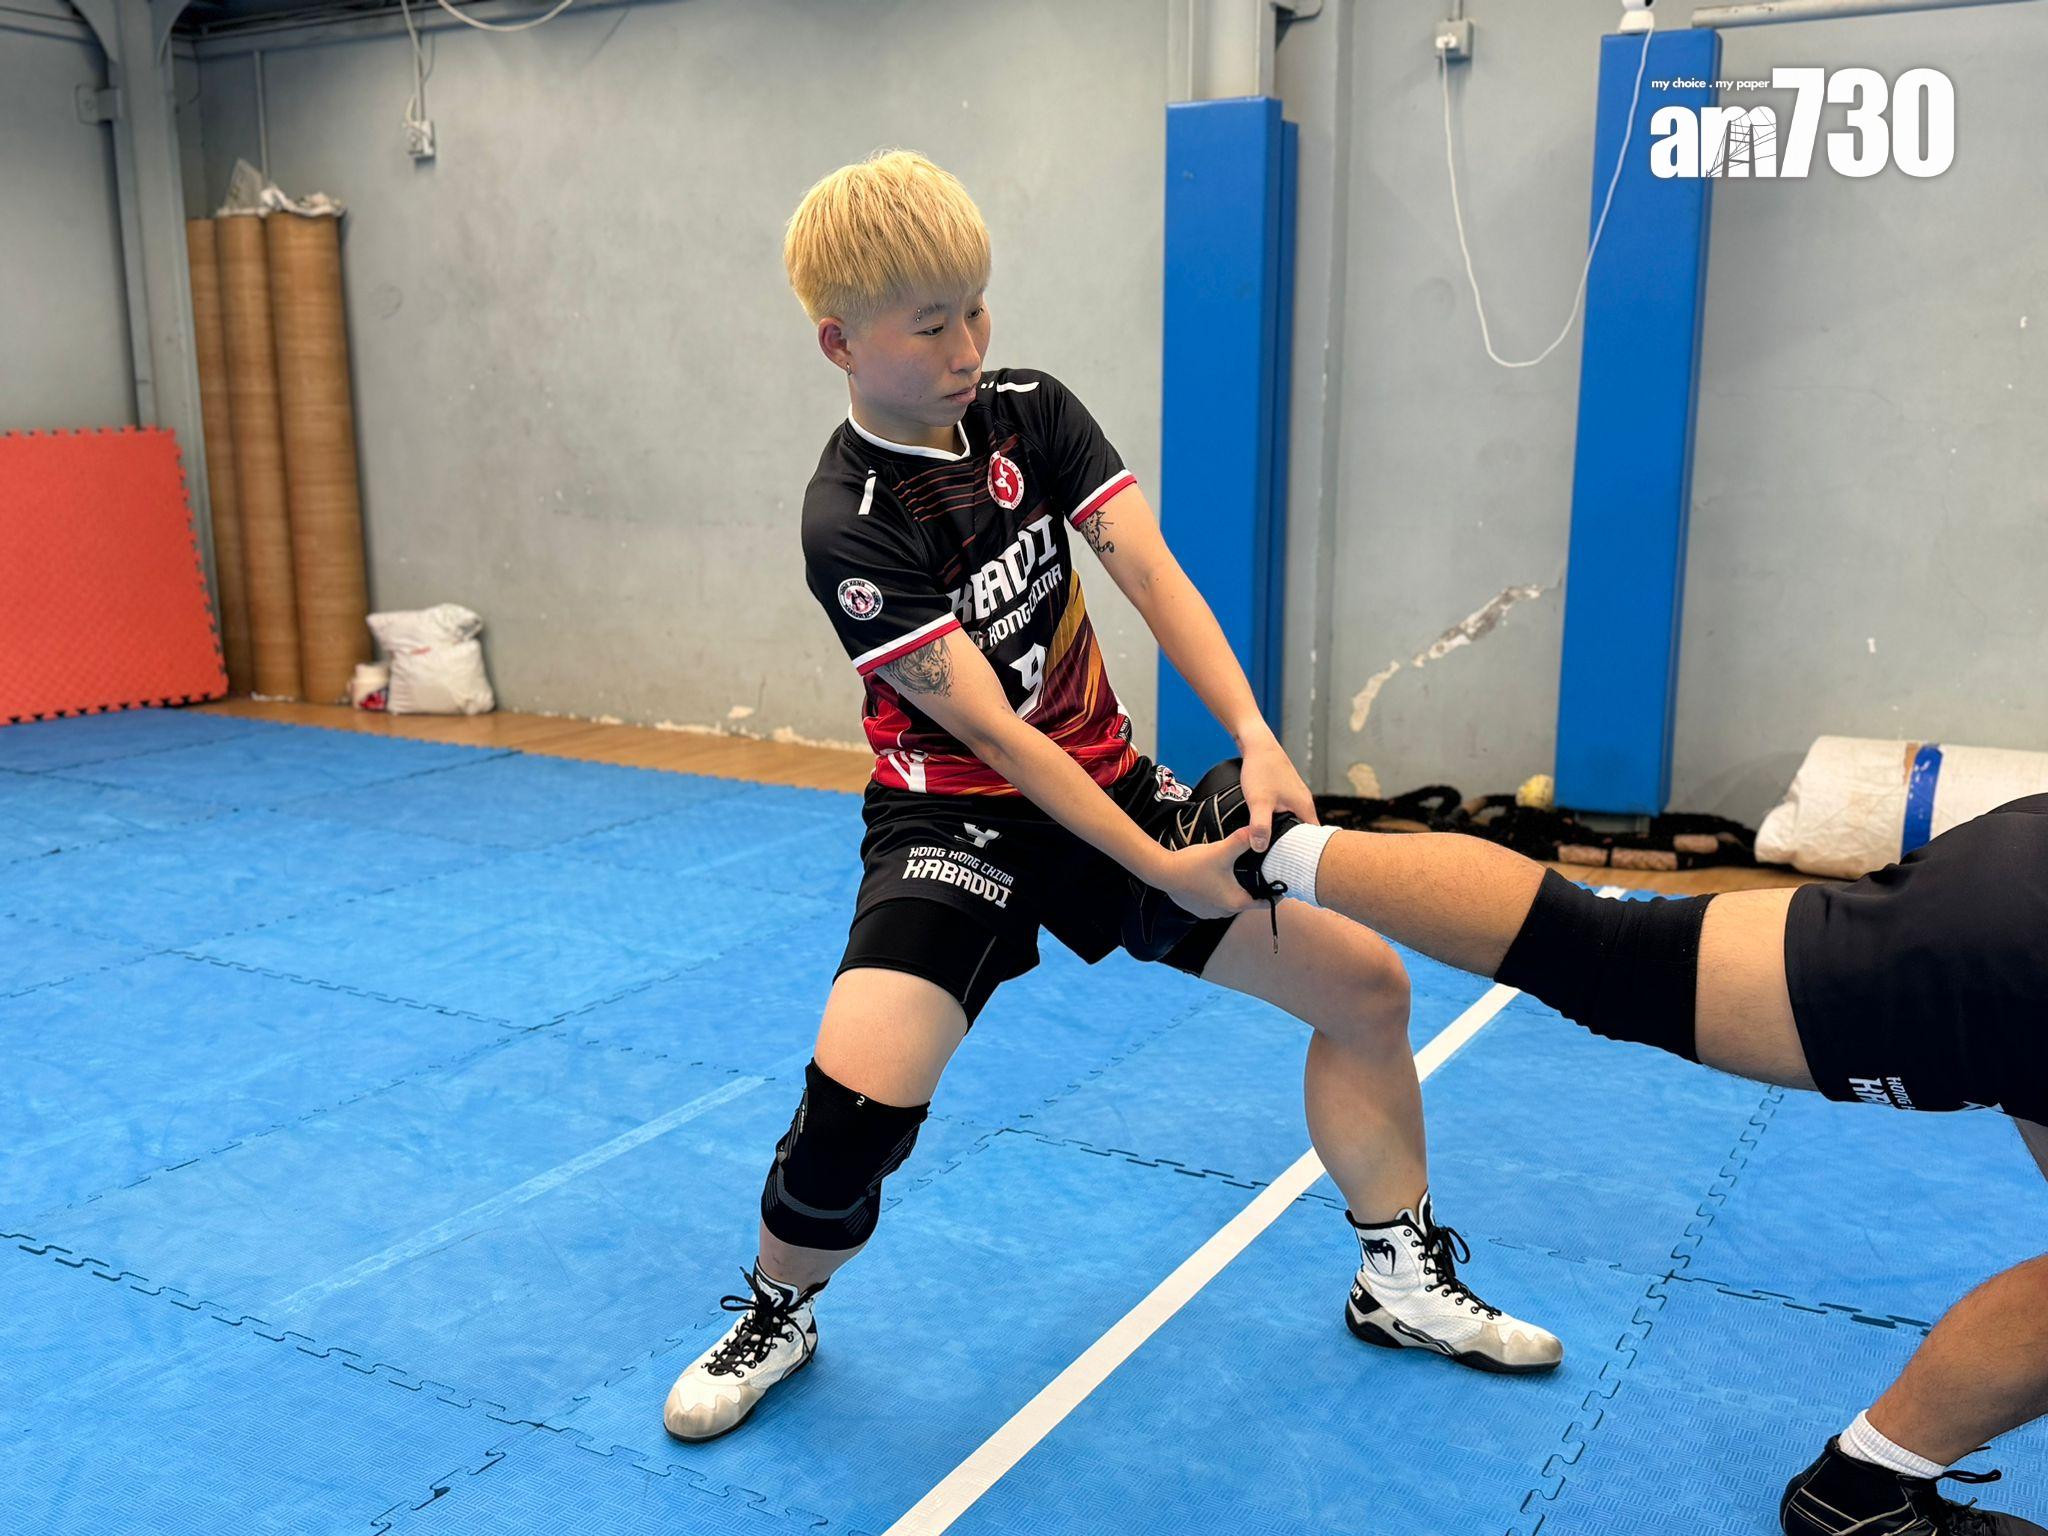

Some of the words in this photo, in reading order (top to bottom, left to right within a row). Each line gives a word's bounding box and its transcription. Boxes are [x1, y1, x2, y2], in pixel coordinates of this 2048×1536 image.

[902, 858, 1013, 909] KABADDI
[909, 846, 947, 858] HONG
[948, 850, 982, 869] KONG
[980, 862, 1014, 887] CHINA
